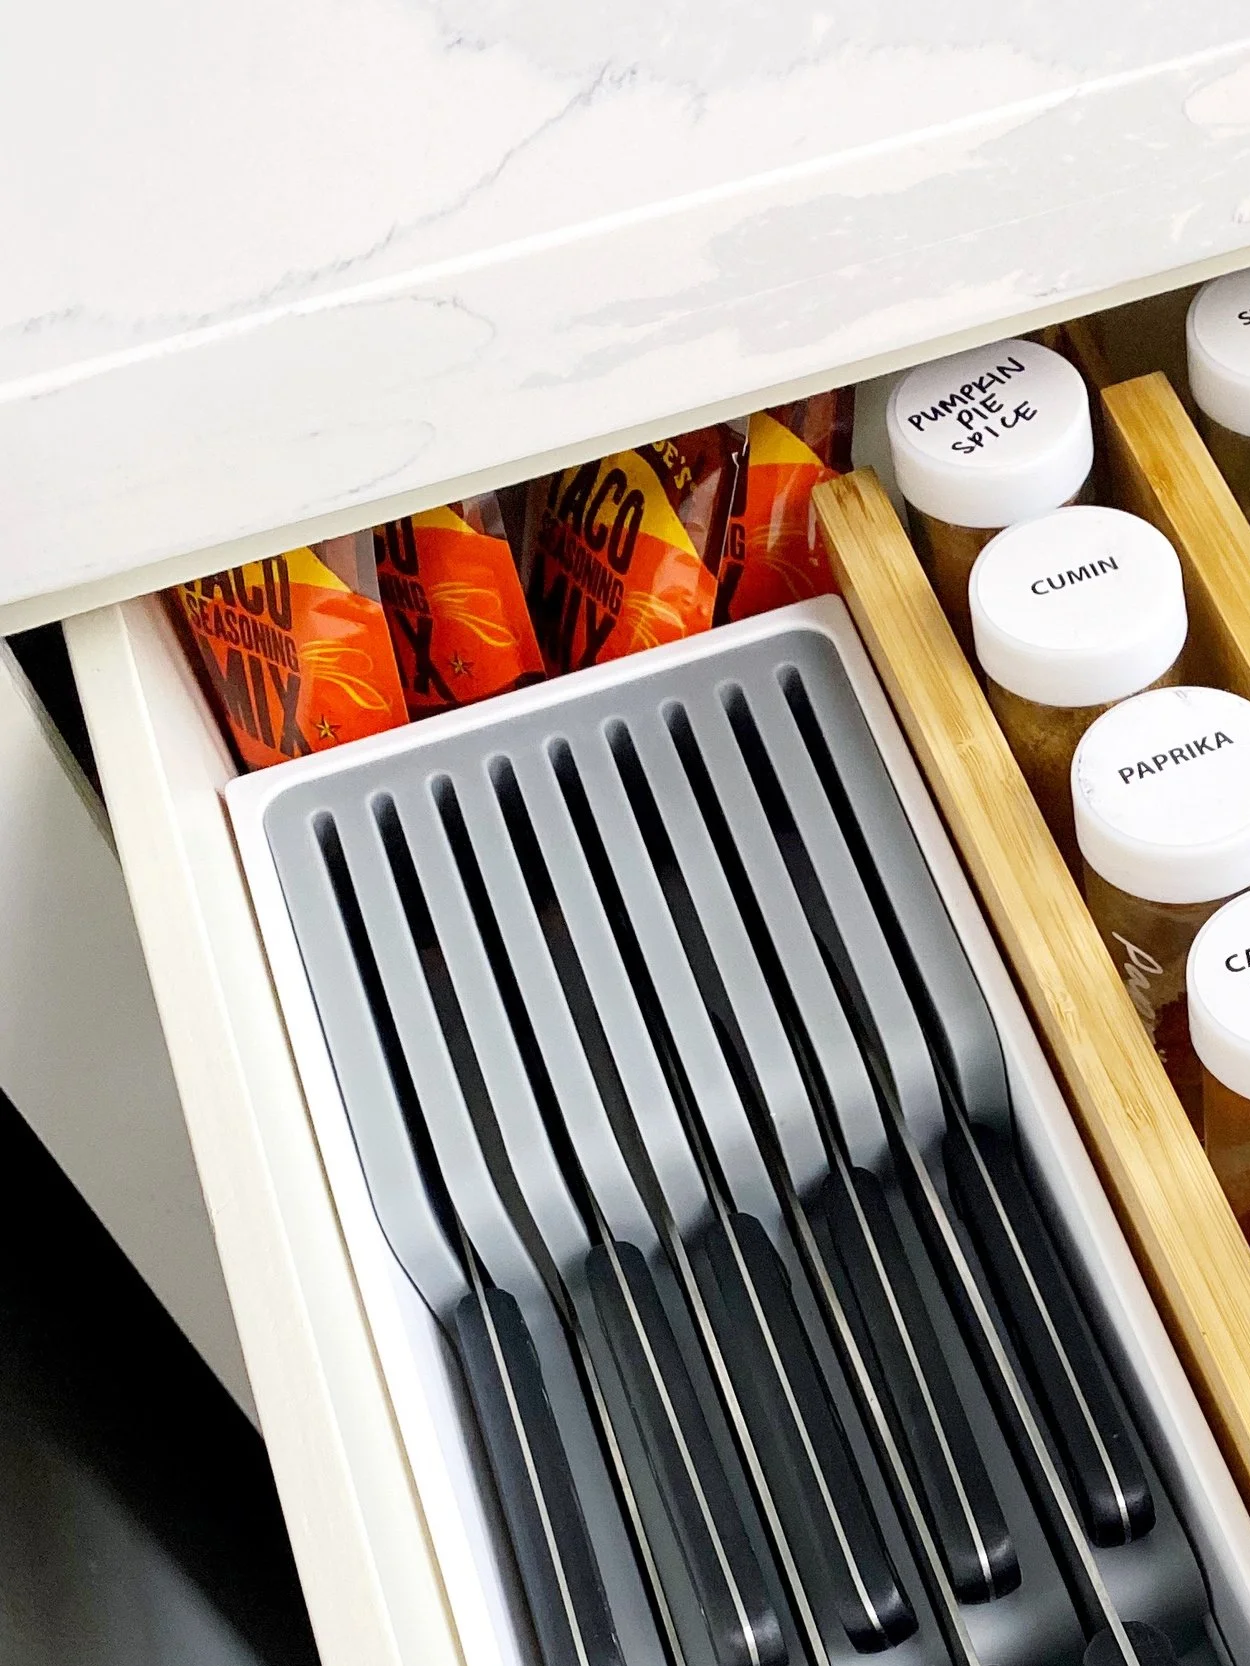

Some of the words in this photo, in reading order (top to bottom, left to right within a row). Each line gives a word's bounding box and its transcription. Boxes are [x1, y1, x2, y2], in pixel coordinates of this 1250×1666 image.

[907, 356, 1026, 432] PUMPKIN
[955, 392, 1005, 432] PIE
[951, 400, 1038, 455] SPICE
[177, 553, 293, 633] ACO
[1031, 556, 1119, 595] CUMIN
[185, 589, 300, 673] SEASONING
[198, 635, 314, 758] MIX
[1118, 731, 1234, 785] PAPRIKA
